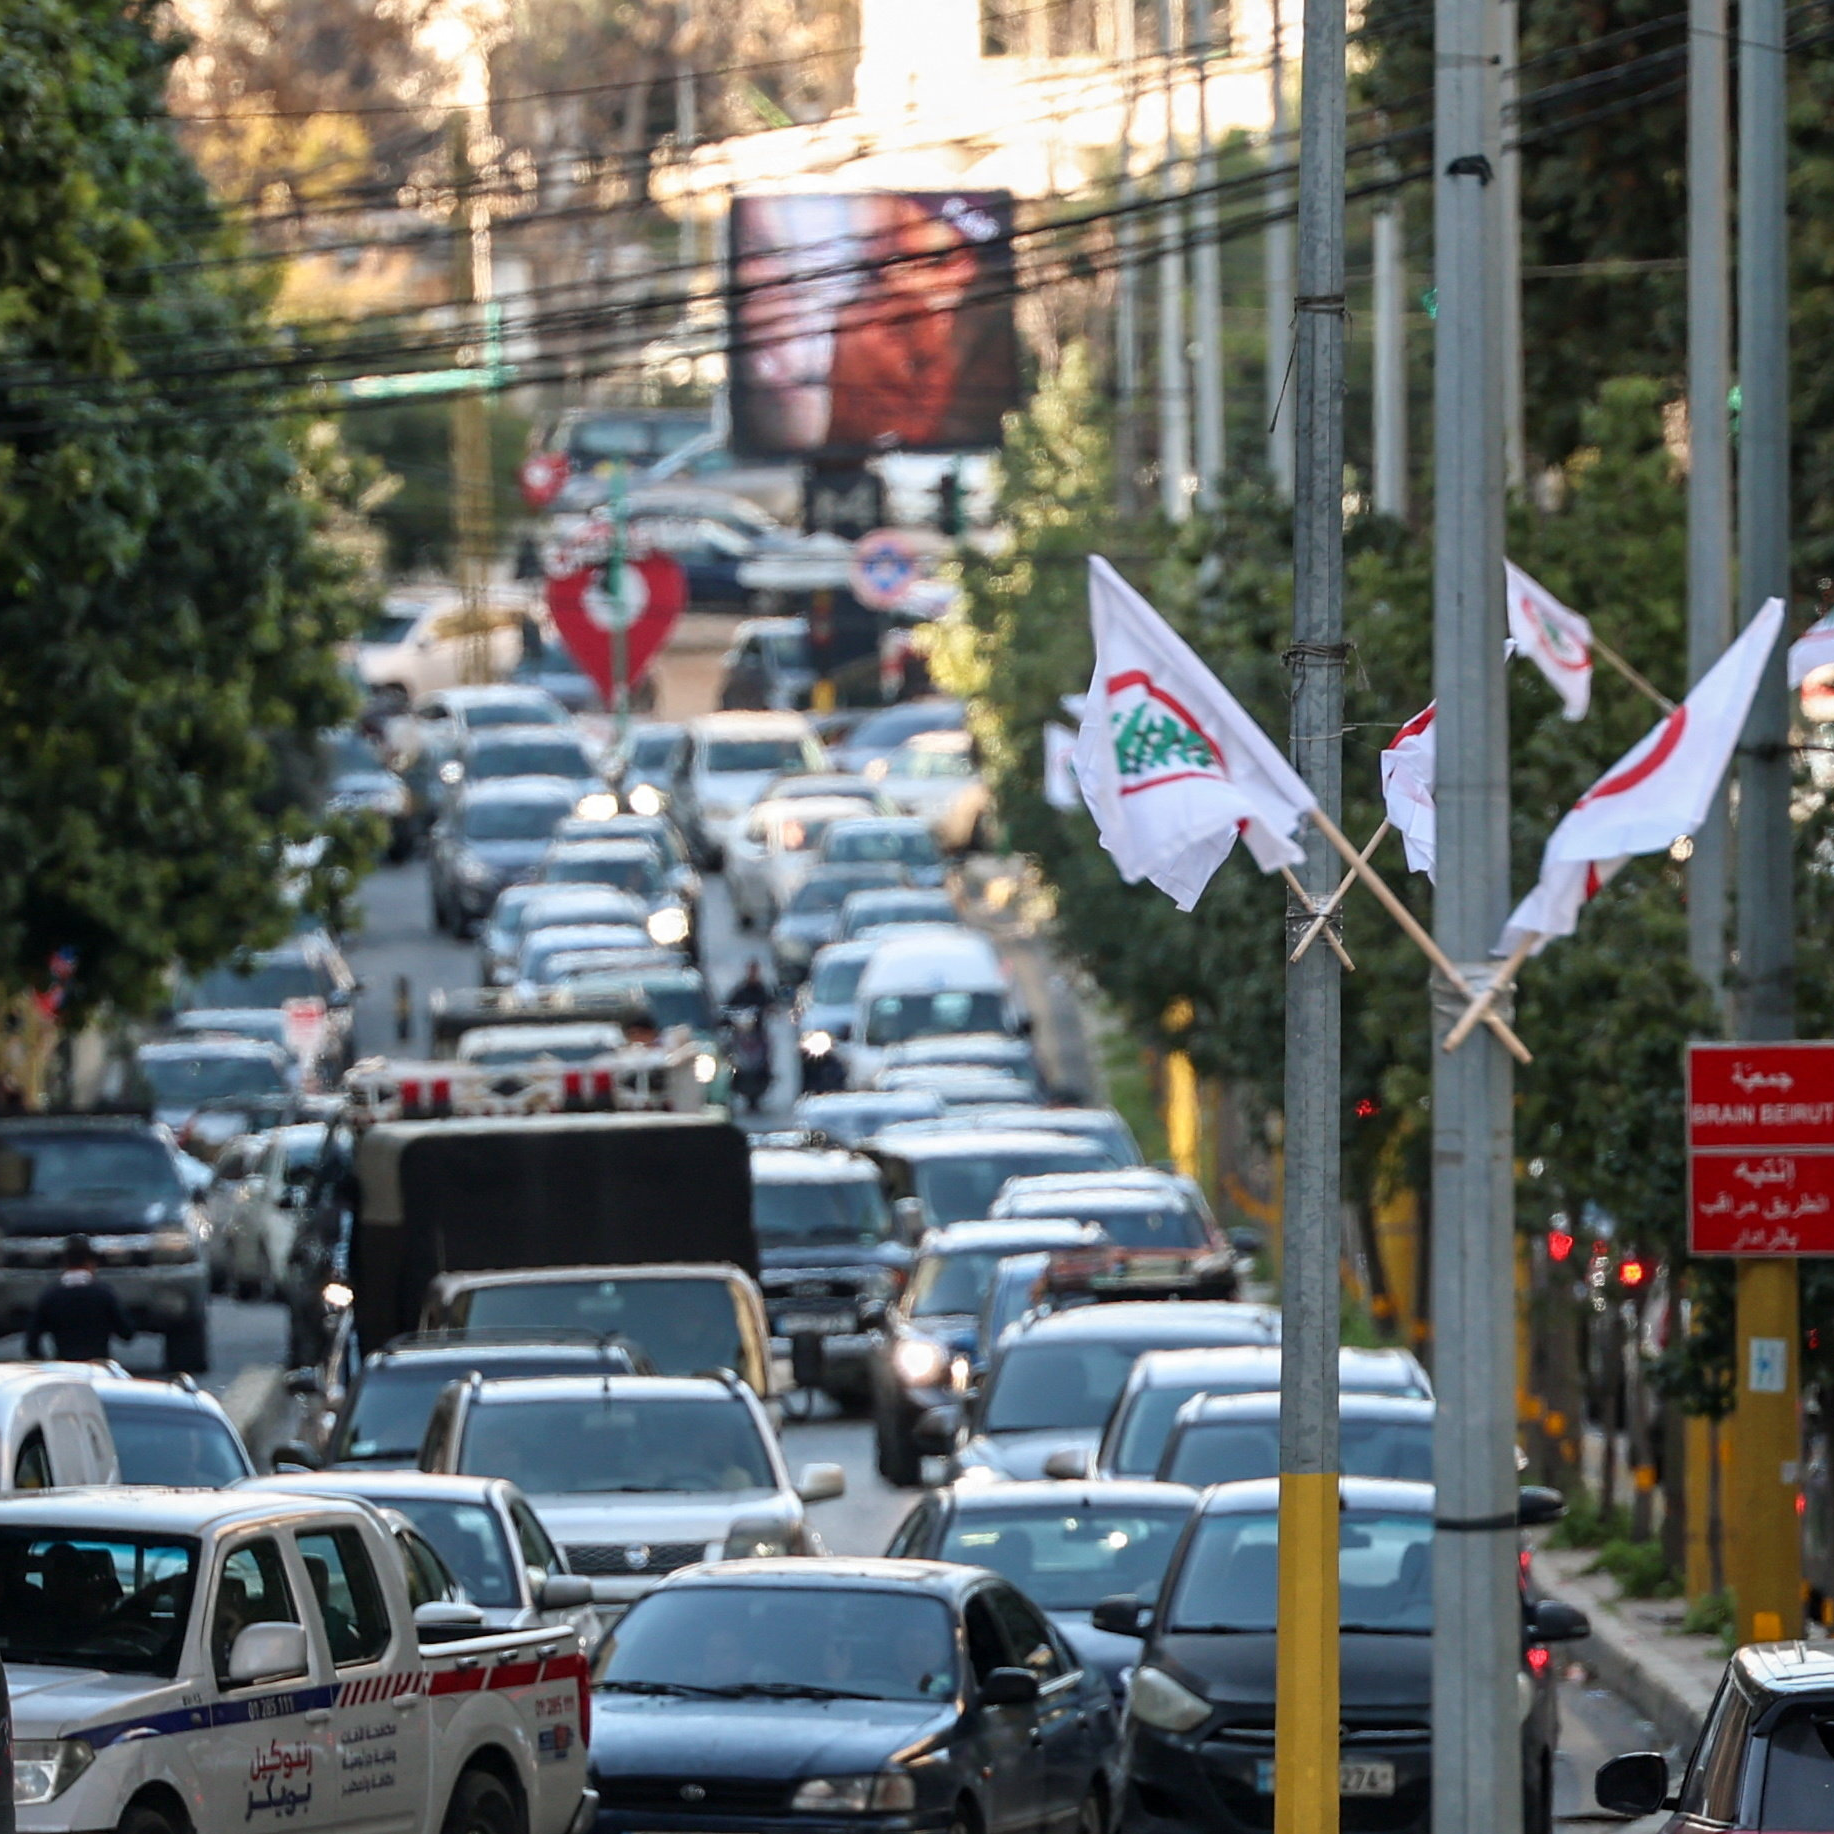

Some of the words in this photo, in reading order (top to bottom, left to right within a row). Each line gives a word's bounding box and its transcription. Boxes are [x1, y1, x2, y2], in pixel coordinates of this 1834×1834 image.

[1691, 1102, 1755, 1126] BRAIN
[250, 1738, 313, 1782] رنتوكيل
[245, 1774, 312, 1822] بويكر
